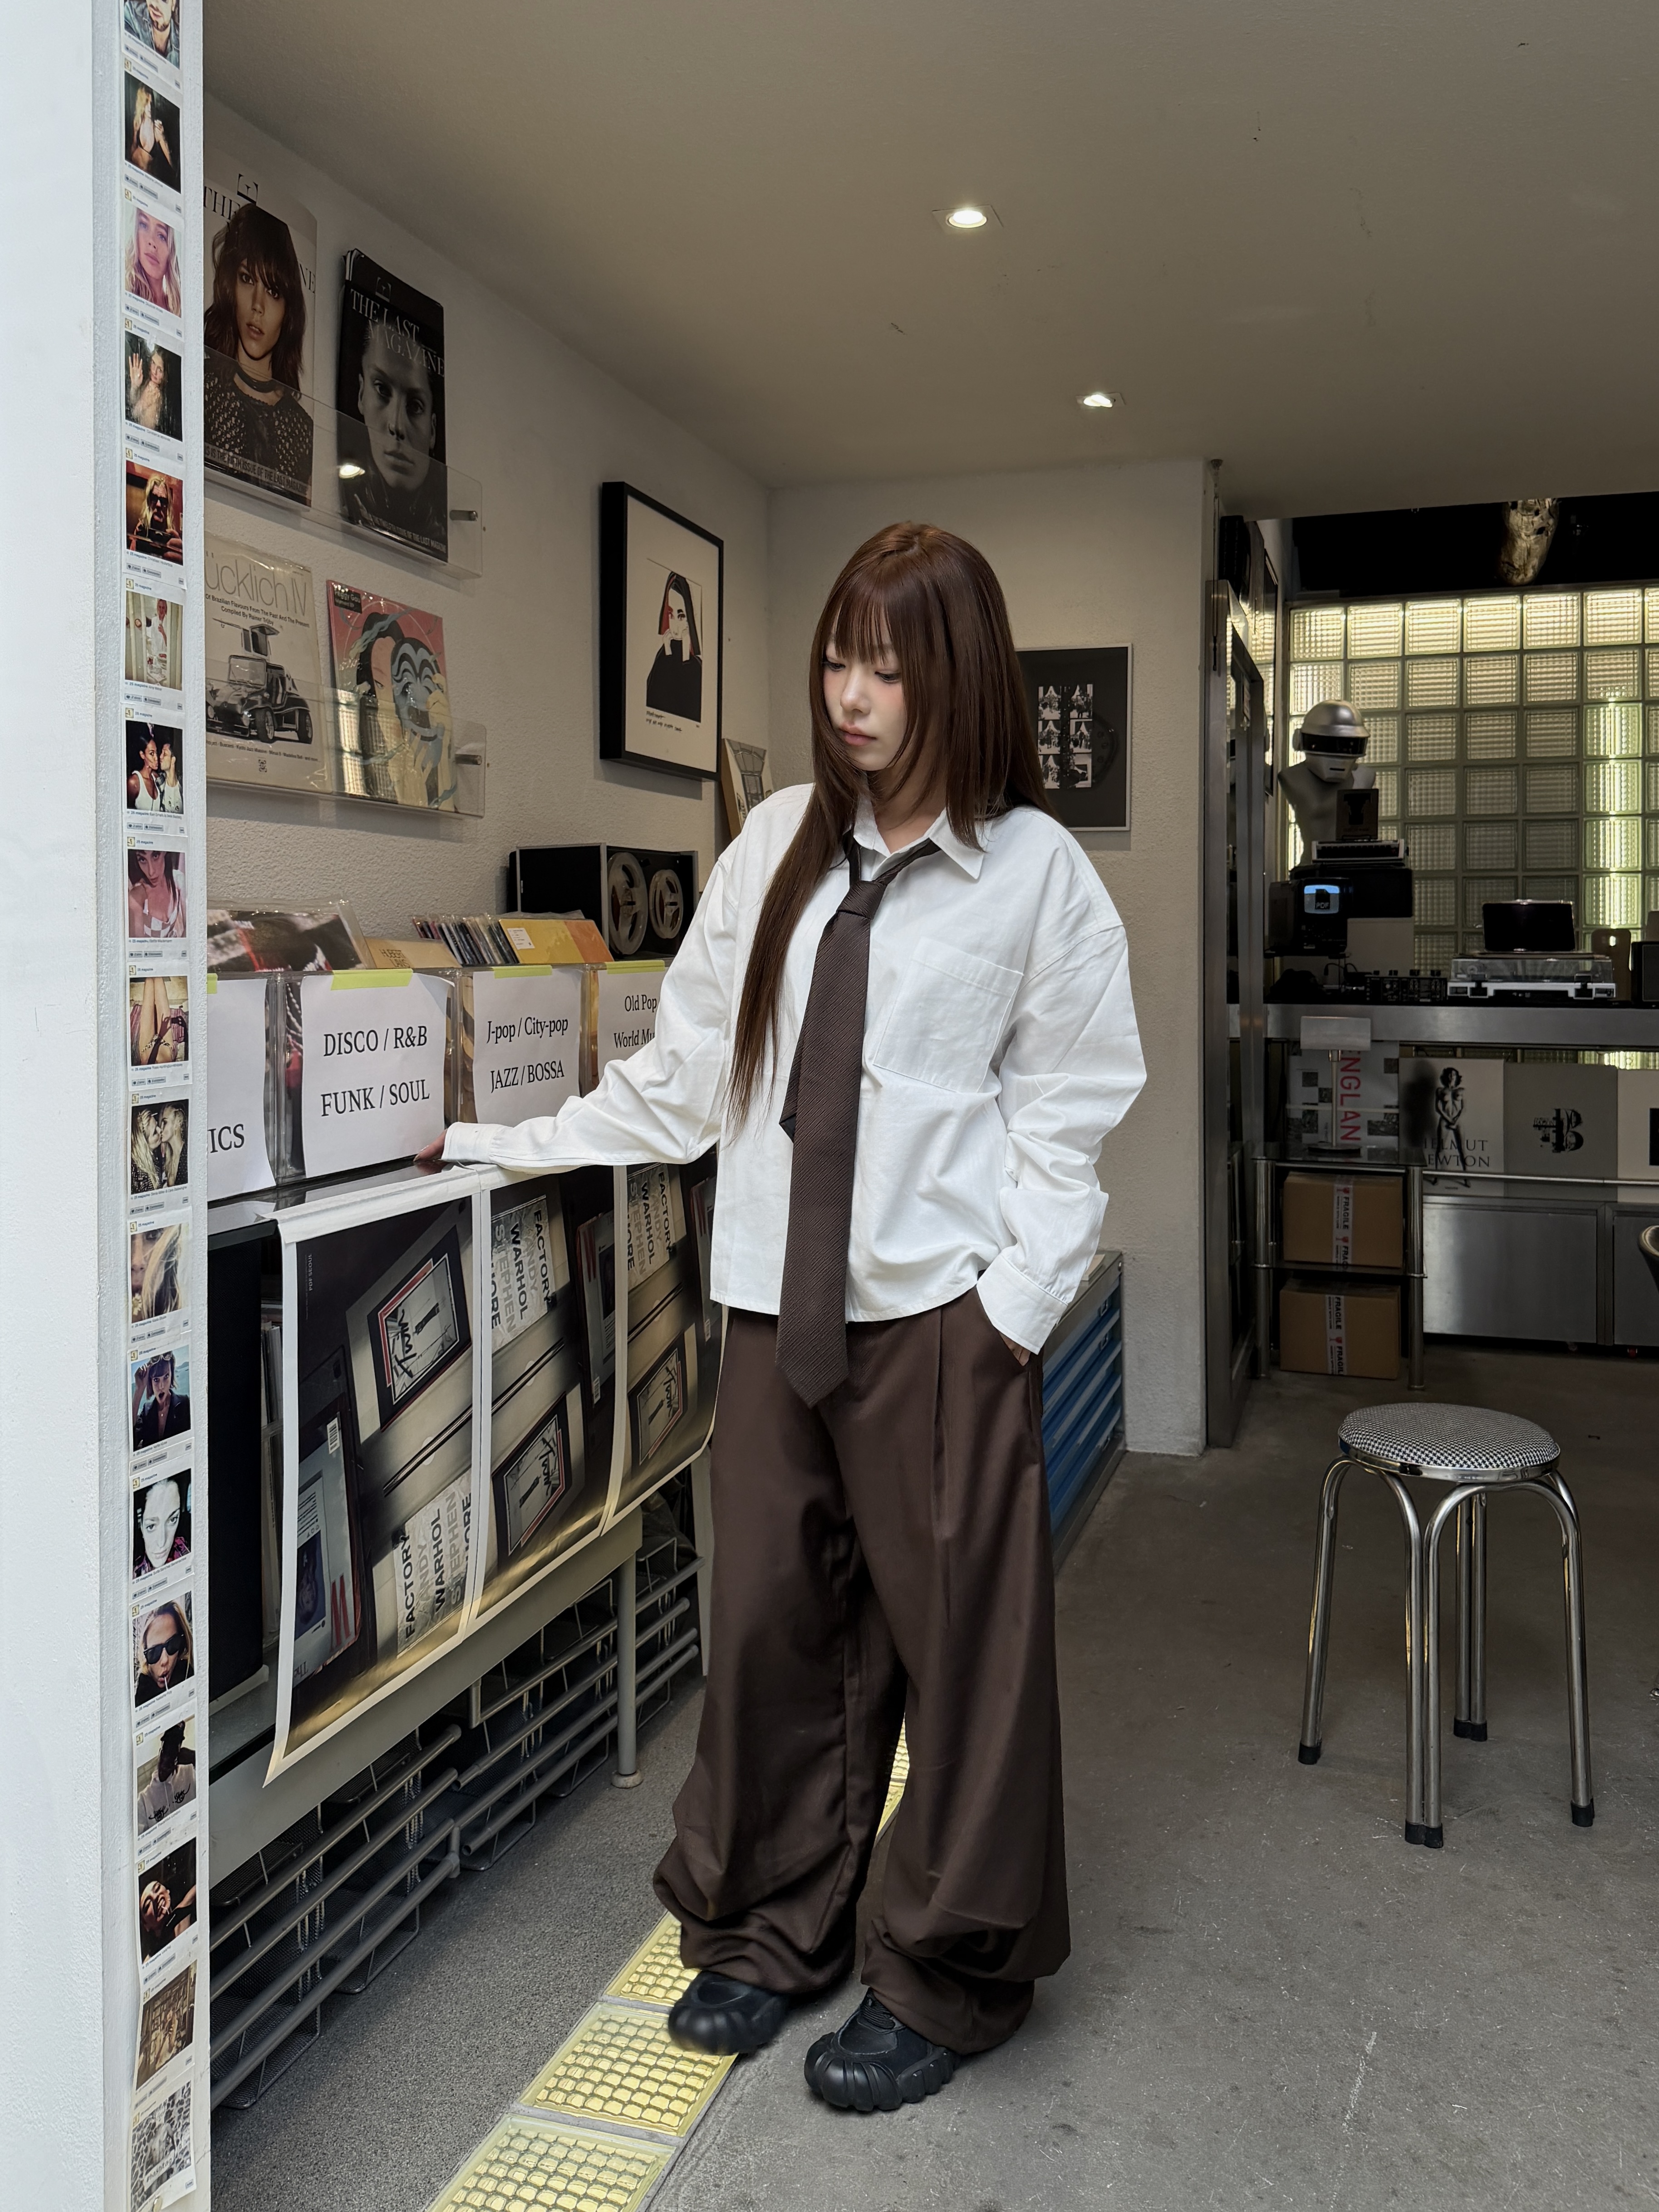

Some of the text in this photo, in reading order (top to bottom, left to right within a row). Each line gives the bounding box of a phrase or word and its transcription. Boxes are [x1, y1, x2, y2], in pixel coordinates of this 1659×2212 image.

[351, 289, 420, 343] THE LAST
[366, 319, 444, 378] MAGAZINE
[211, 595, 231, 606] Brazilian
[231, 600, 249, 611] Flavours
[249, 606, 260, 614] From
[221, 606, 241, 617] Compiled
[242, 611, 248, 619] By
[291, 577, 307, 617] IV
[486, 1016, 568, 1044] J-pop / City-pop
[624, 994, 657, 1013] Old Pop
[323, 1025, 427, 1057] DISCO / R&B
[614, 1029, 639, 1049] World
[320, 1079, 430, 1117] FUNK / SOUL
[490, 1059, 565, 1094] JAZZ / BOSSA
[1340, 1050, 1361, 1141] NGLAN
[207, 1123, 245, 1153] ICS
[1428, 1153, 1490, 1168] EWTON
[629, 1182, 647, 1275] STEPHEN
[641, 1181, 655, 1265] WARHOL
[658, 1171, 672, 1252] FACTORY
[495, 1224, 516, 1334] STEPHEN
[510, 1223, 528, 1320] WARHOL
[534, 1209, 552, 1303] FACTORY
[431, 1507, 446, 1614] WARHOL
[445, 1491, 461, 1605] STEPHEN
[399, 1534, 416, 1639] FACTORY
